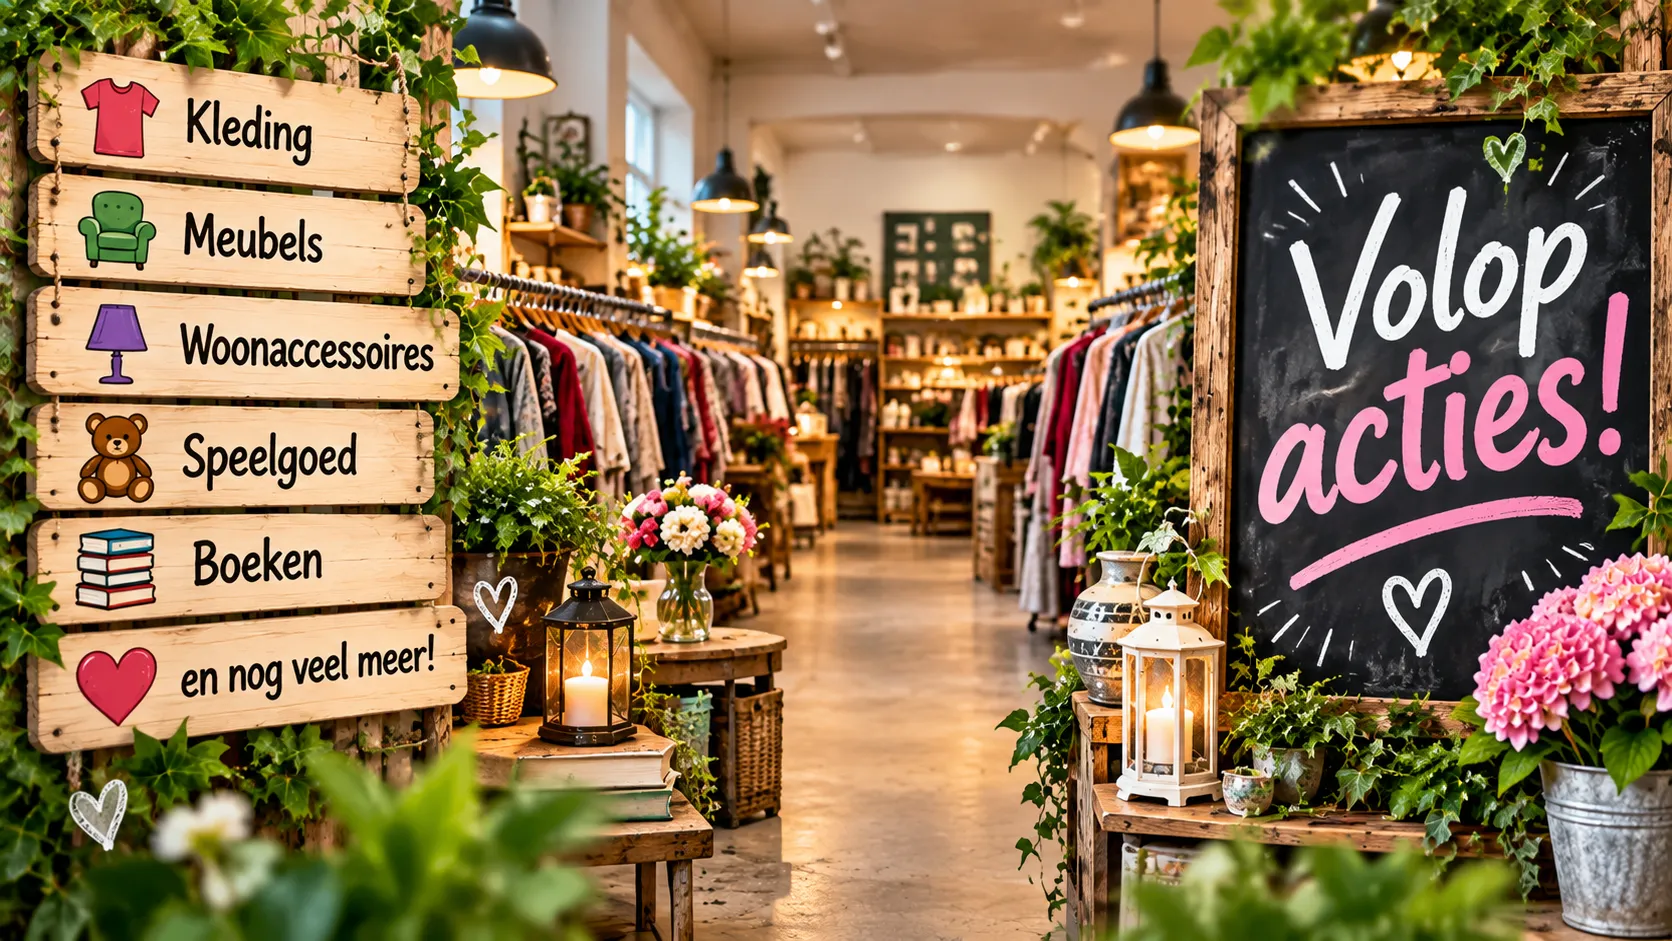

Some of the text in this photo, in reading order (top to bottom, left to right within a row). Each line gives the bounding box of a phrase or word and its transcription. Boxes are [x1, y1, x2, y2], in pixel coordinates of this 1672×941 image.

[188, 98, 312, 166] Kleding
[184, 212, 322, 263] Meubels
[1289, 186, 1588, 370] Volop
[180, 323, 433, 371] Woonaccessoires
[1258, 291, 1629, 524] acties!
[183, 432, 356, 491] Speelgoed
[194, 537, 322, 586] Boeken
[182, 634, 434, 700] en nog veel meer!
